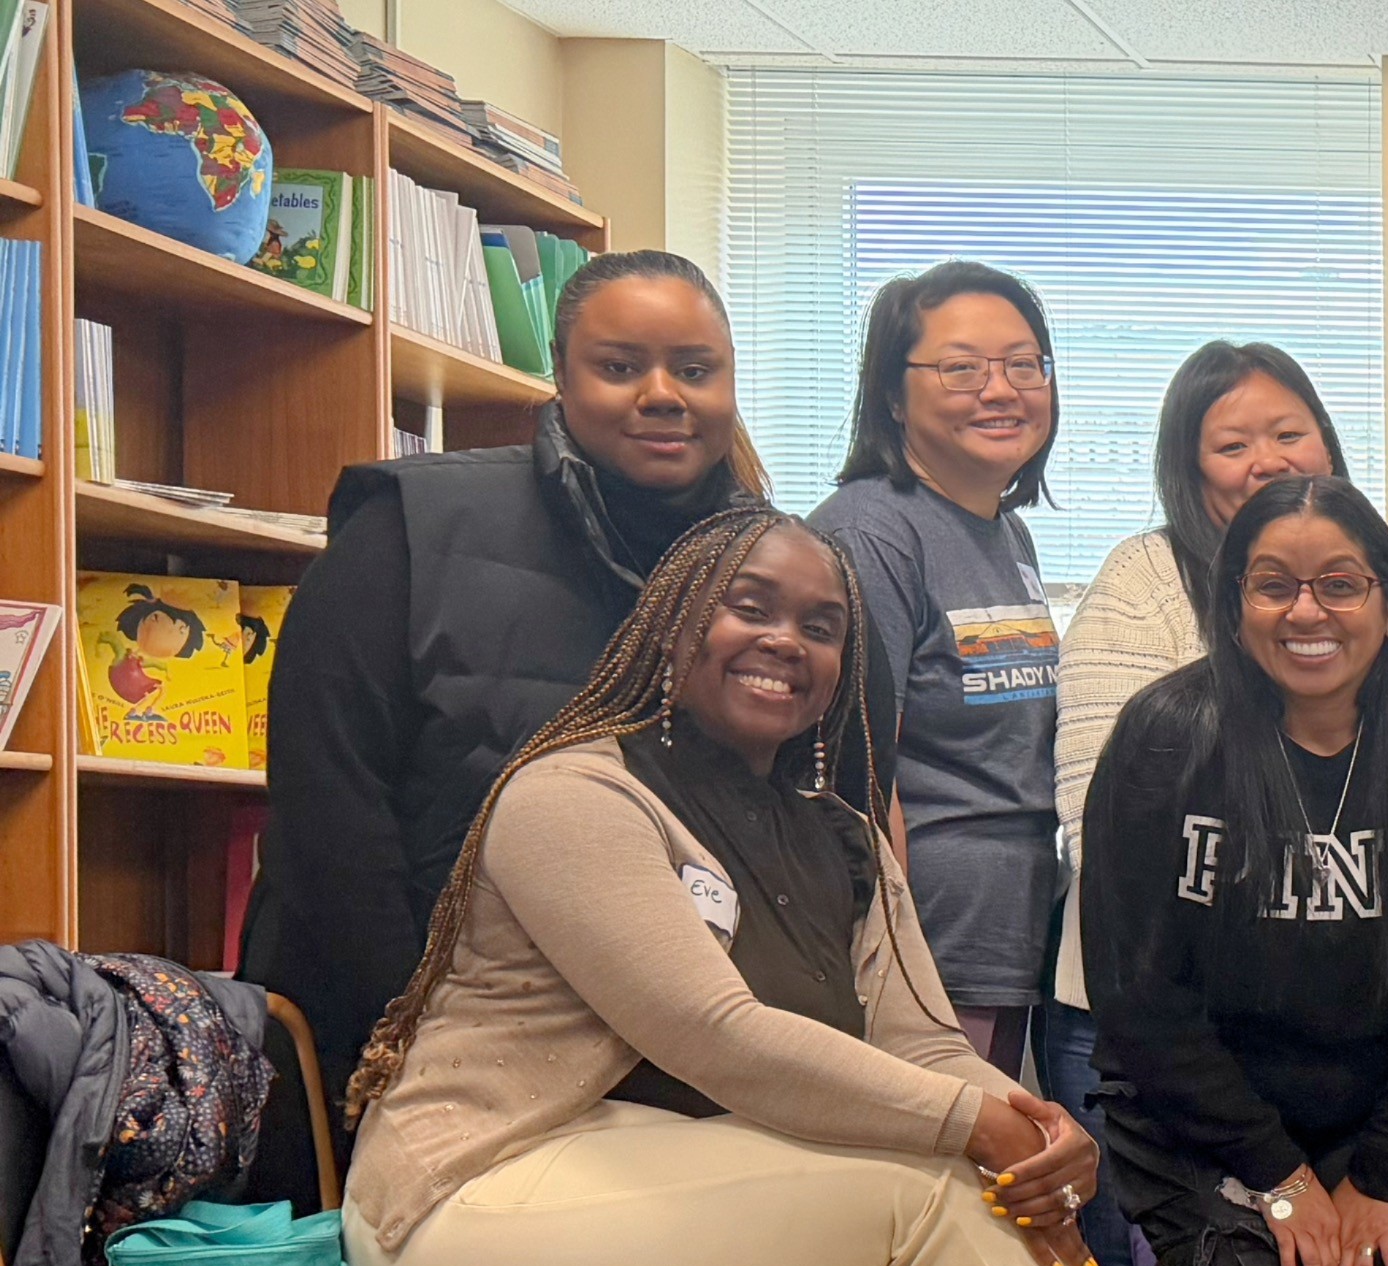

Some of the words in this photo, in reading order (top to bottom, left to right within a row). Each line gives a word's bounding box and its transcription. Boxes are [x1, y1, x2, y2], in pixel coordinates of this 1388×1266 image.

[271, 192, 319, 210] etables
[961, 665, 1044, 693] SHADY
[110, 720, 178, 745] RECESS
[179, 710, 232, 735] QUEEN
[690, 879, 722, 904] Eve
